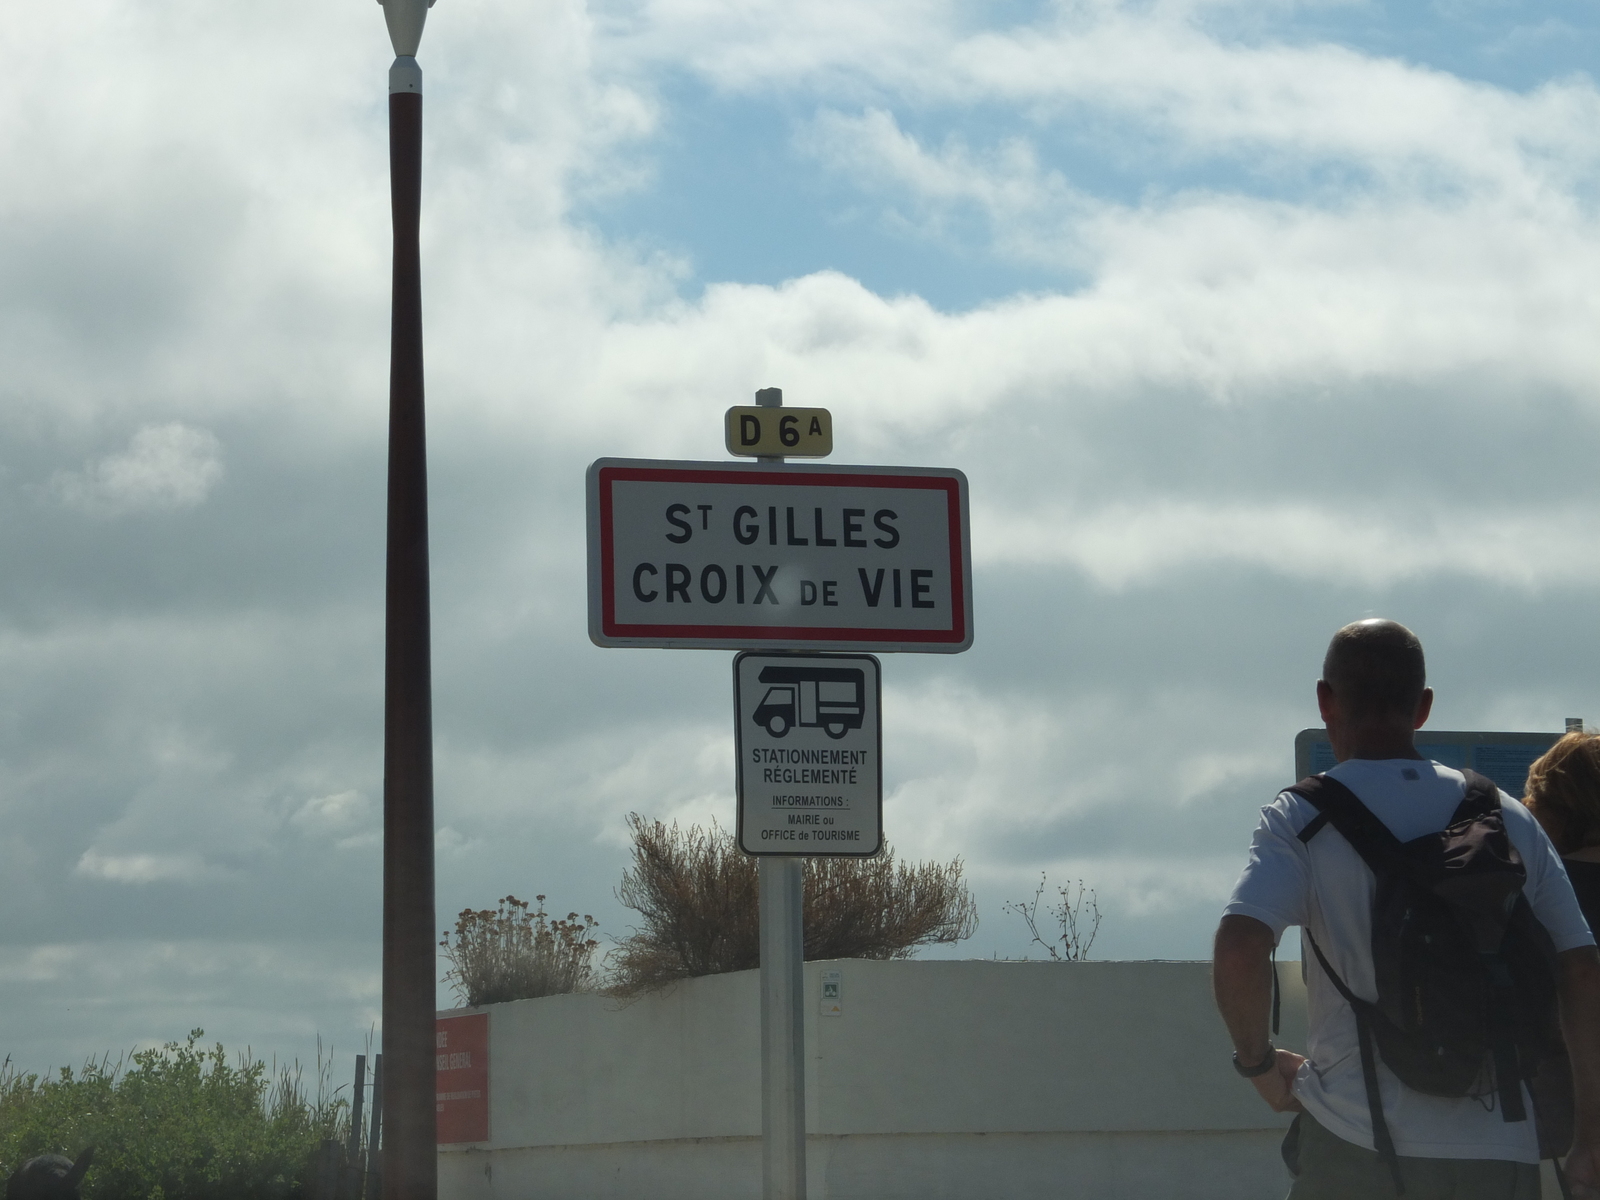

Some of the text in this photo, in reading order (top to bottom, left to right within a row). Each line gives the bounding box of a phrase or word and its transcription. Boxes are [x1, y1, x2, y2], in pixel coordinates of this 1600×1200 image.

[740, 414, 761, 446] D
[733, 505, 900, 549] GILLES
[632, 562, 935, 609] CROIX DE VIE
[752, 748, 867, 765] STATIONNEMENT
[764, 765, 857, 784] RÉGLEMENTÉ
[772, 795, 843, 807] INFORMATIONS
[788, 814, 834, 825] MAIRIE ou
[761, 830, 860, 841] OFFICE de TOURISME
